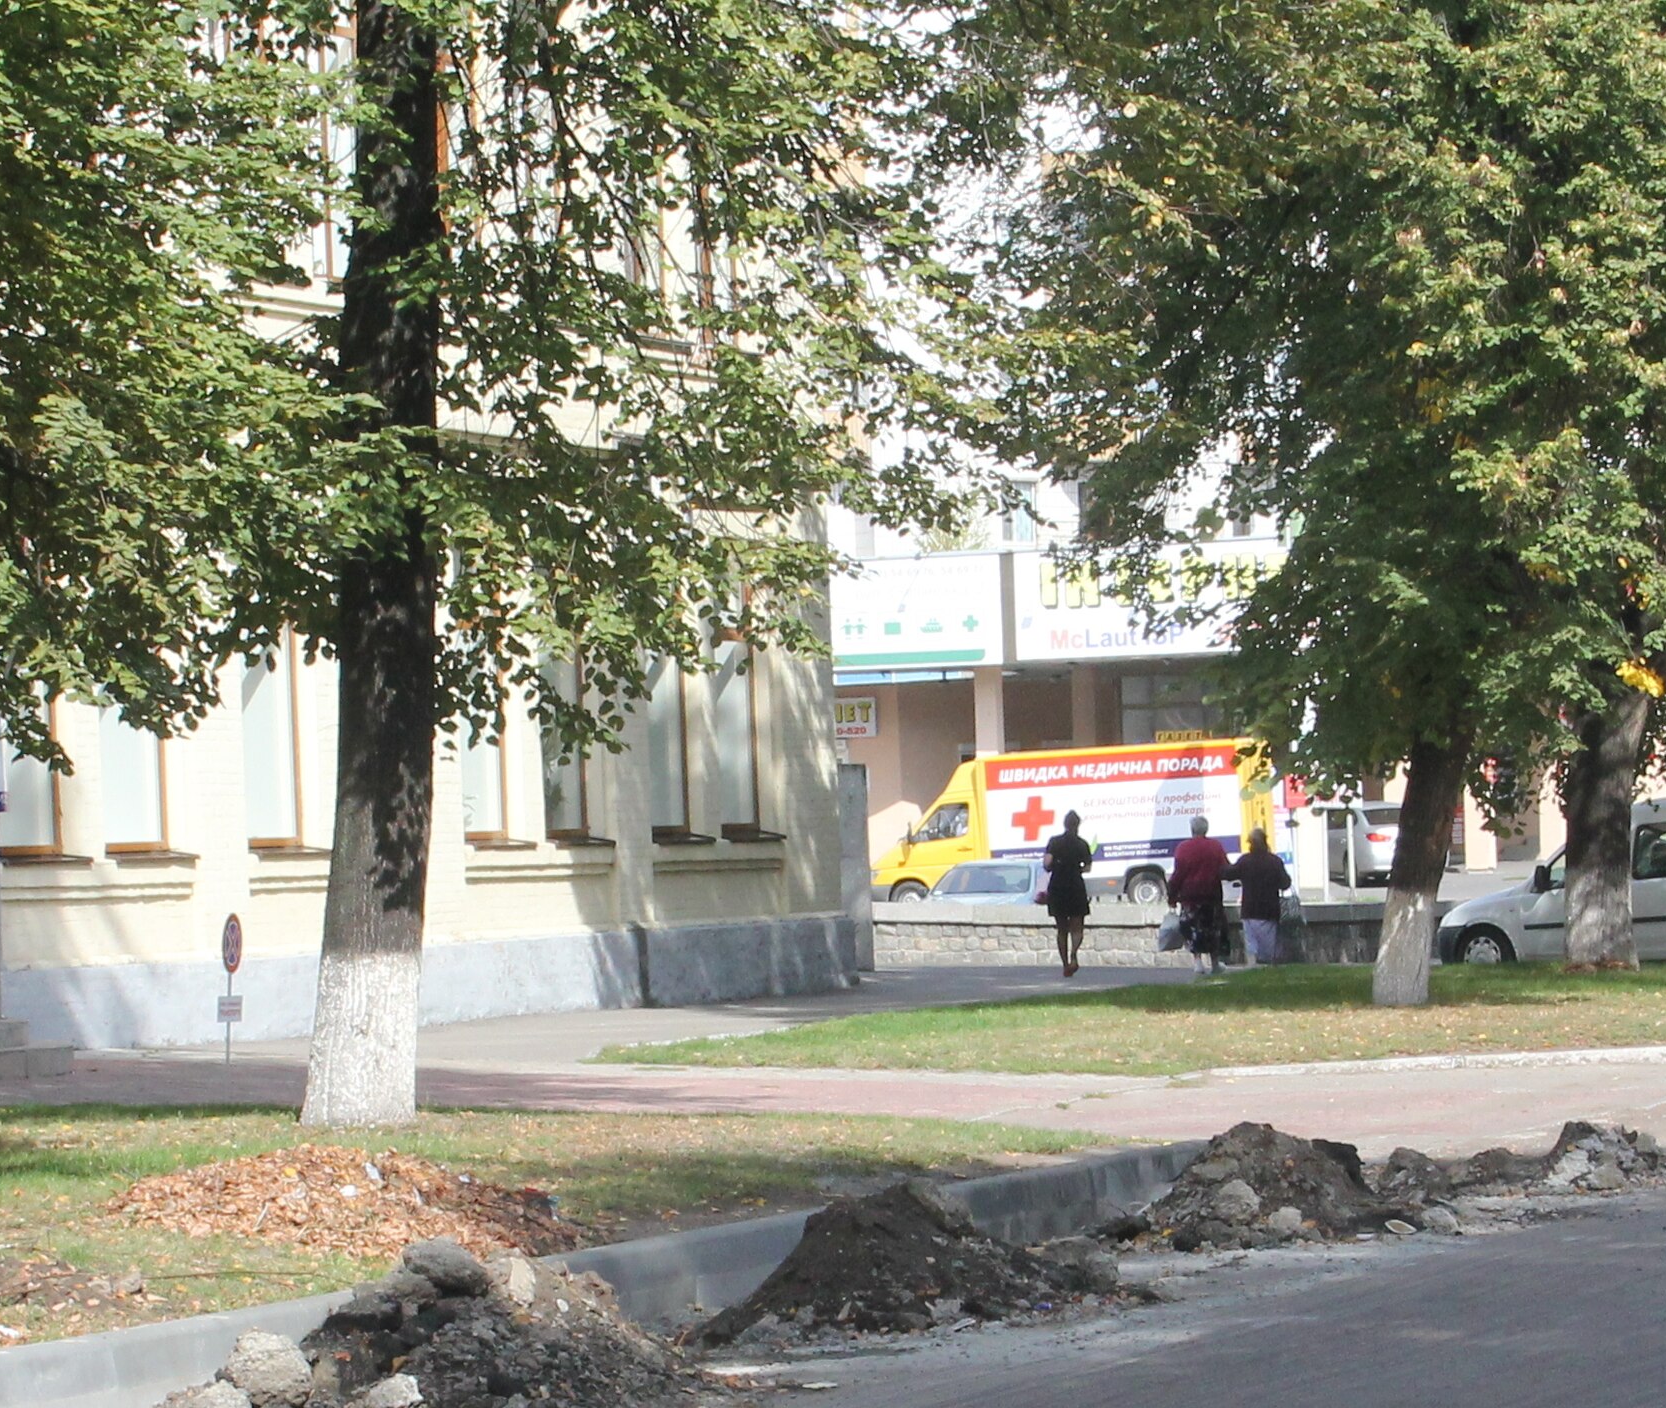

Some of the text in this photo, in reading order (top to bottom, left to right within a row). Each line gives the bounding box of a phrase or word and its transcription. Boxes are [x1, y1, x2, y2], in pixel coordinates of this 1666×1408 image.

[1050, 626, 1137, 650] McLaut
[998, 754, 1224, 784] ШВИДКА МЕДИЧНА ПОРАДА
